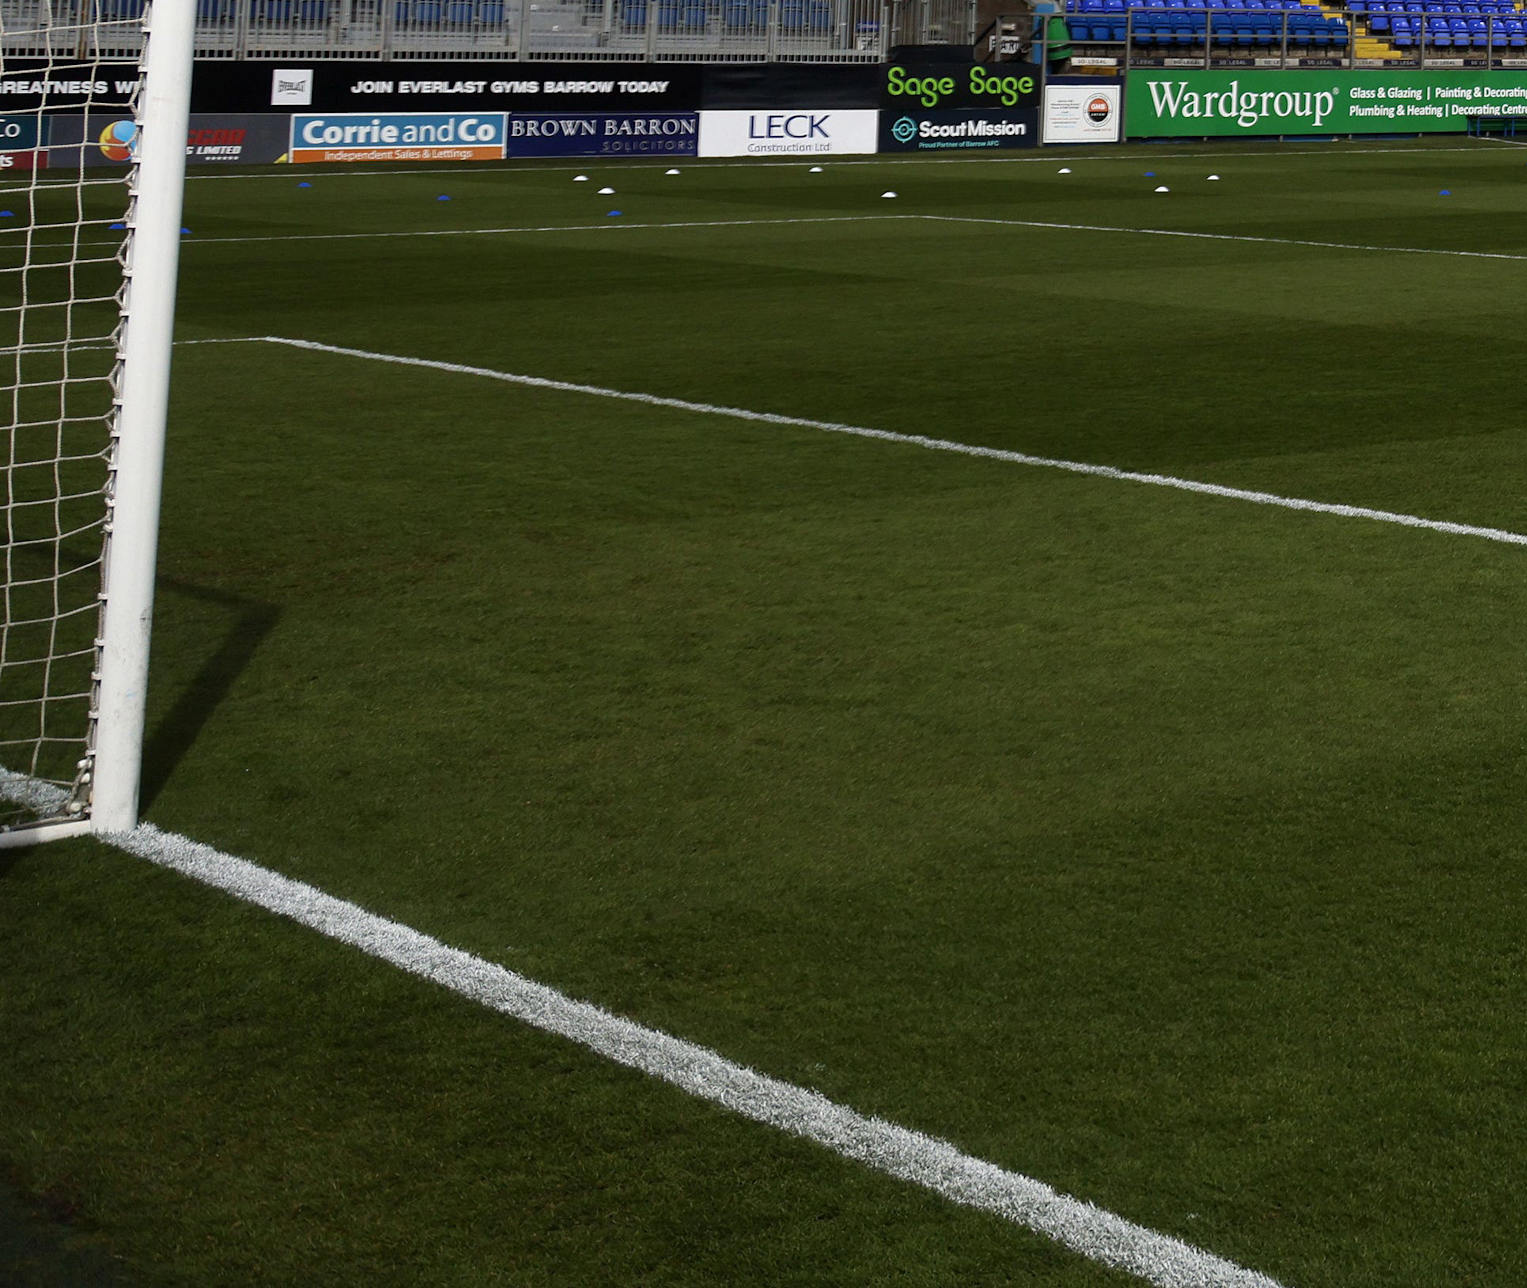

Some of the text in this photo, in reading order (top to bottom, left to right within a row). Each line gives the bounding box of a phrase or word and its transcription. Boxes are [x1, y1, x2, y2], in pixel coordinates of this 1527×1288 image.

[351, 81, 670, 94] JOIN EVERLAST GYMS BARROW TODAY
[887, 66, 1034, 108] Sage Sage
[1350, 87, 1375, 99] Glass
[1377, 87, 1386, 99] &
[1387, 87, 1422, 101] Glazing
[1435, 87, 1472, 100] Painting
[1474, 87, 1482, 98] &
[1147, 80, 1334, 127] Wardgroup
[1350, 105, 1395, 118] Plumbing
[1397, 105, 1405, 116] &
[1407, 104, 1443, 118] Heating
[1451, 104, 1500, 117] Decorating
[302, 118, 496, 144] Corrie and Co
[511, 118, 696, 137] BROWN BARRON
[749, 115, 830, 139] LECK
[196, 145, 242, 155] LIMITED
[602, 140, 696, 152] SOLICITORS
[747, 143, 830, 153] Construction Ltd
[324, 149, 473, 162] Independent Sales & Lettings
